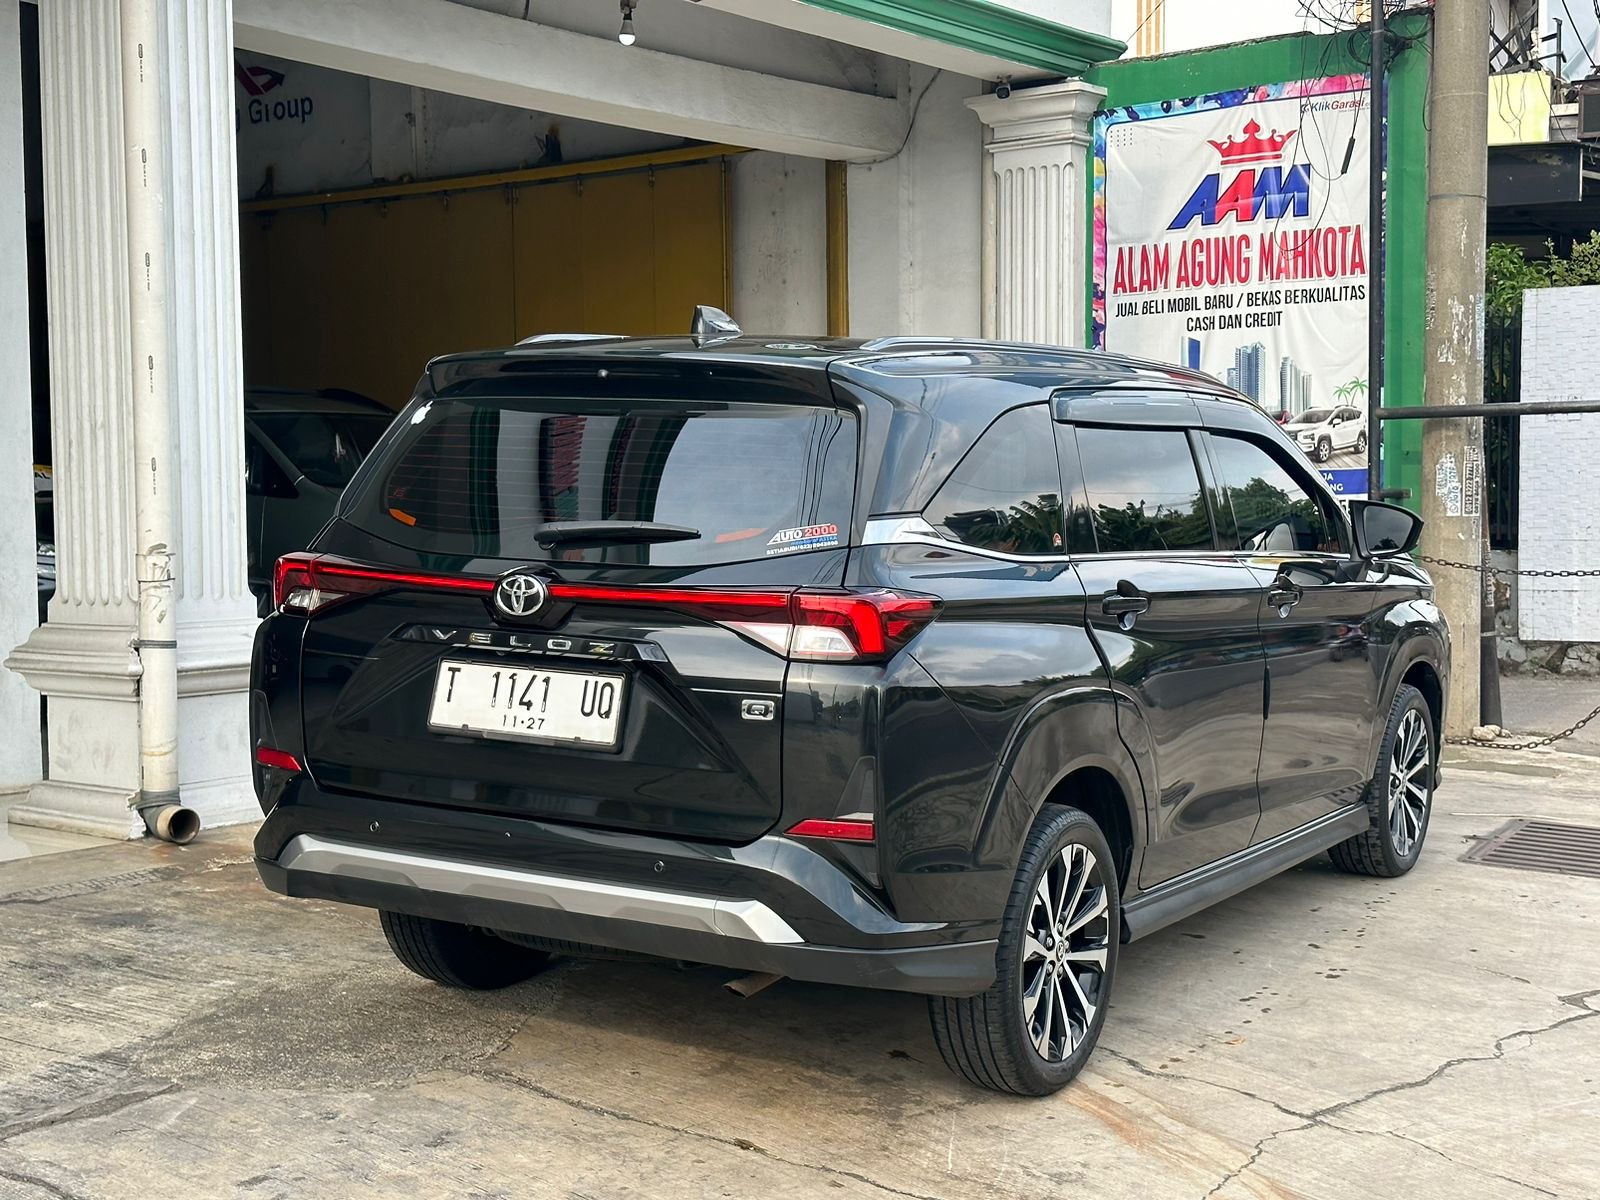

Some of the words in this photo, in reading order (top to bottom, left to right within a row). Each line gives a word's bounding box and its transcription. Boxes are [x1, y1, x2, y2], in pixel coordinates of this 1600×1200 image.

[1166, 163, 1311, 230] AAM
[1113, 242, 1170, 294] ALAM
[1176, 234, 1251, 289] AGUNG
[1258, 226, 1366, 281] MAHKOTA
[1115, 299, 1139, 317] JUAL
[1141, 298, 1164, 315] BELI
[1167, 295, 1201, 313] MOBIL
[1204, 293, 1234, 310] BARU
[1247, 289, 1281, 306] BEKAS
[1285, 285, 1365, 305] BERKUALITAS
[1186, 314, 1215, 332] CASH
[1218, 312, 1243, 330] DAN
[1245, 311, 1283, 328] CREDIT
[766, 529, 803, 546] AUTO
[804, 524, 838, 537] 2000
[431, 628, 616, 655] VELOZ
[447, 667, 461, 703] T
[490, 671, 551, 713] 1141
[580, 679, 615, 720] UQ
